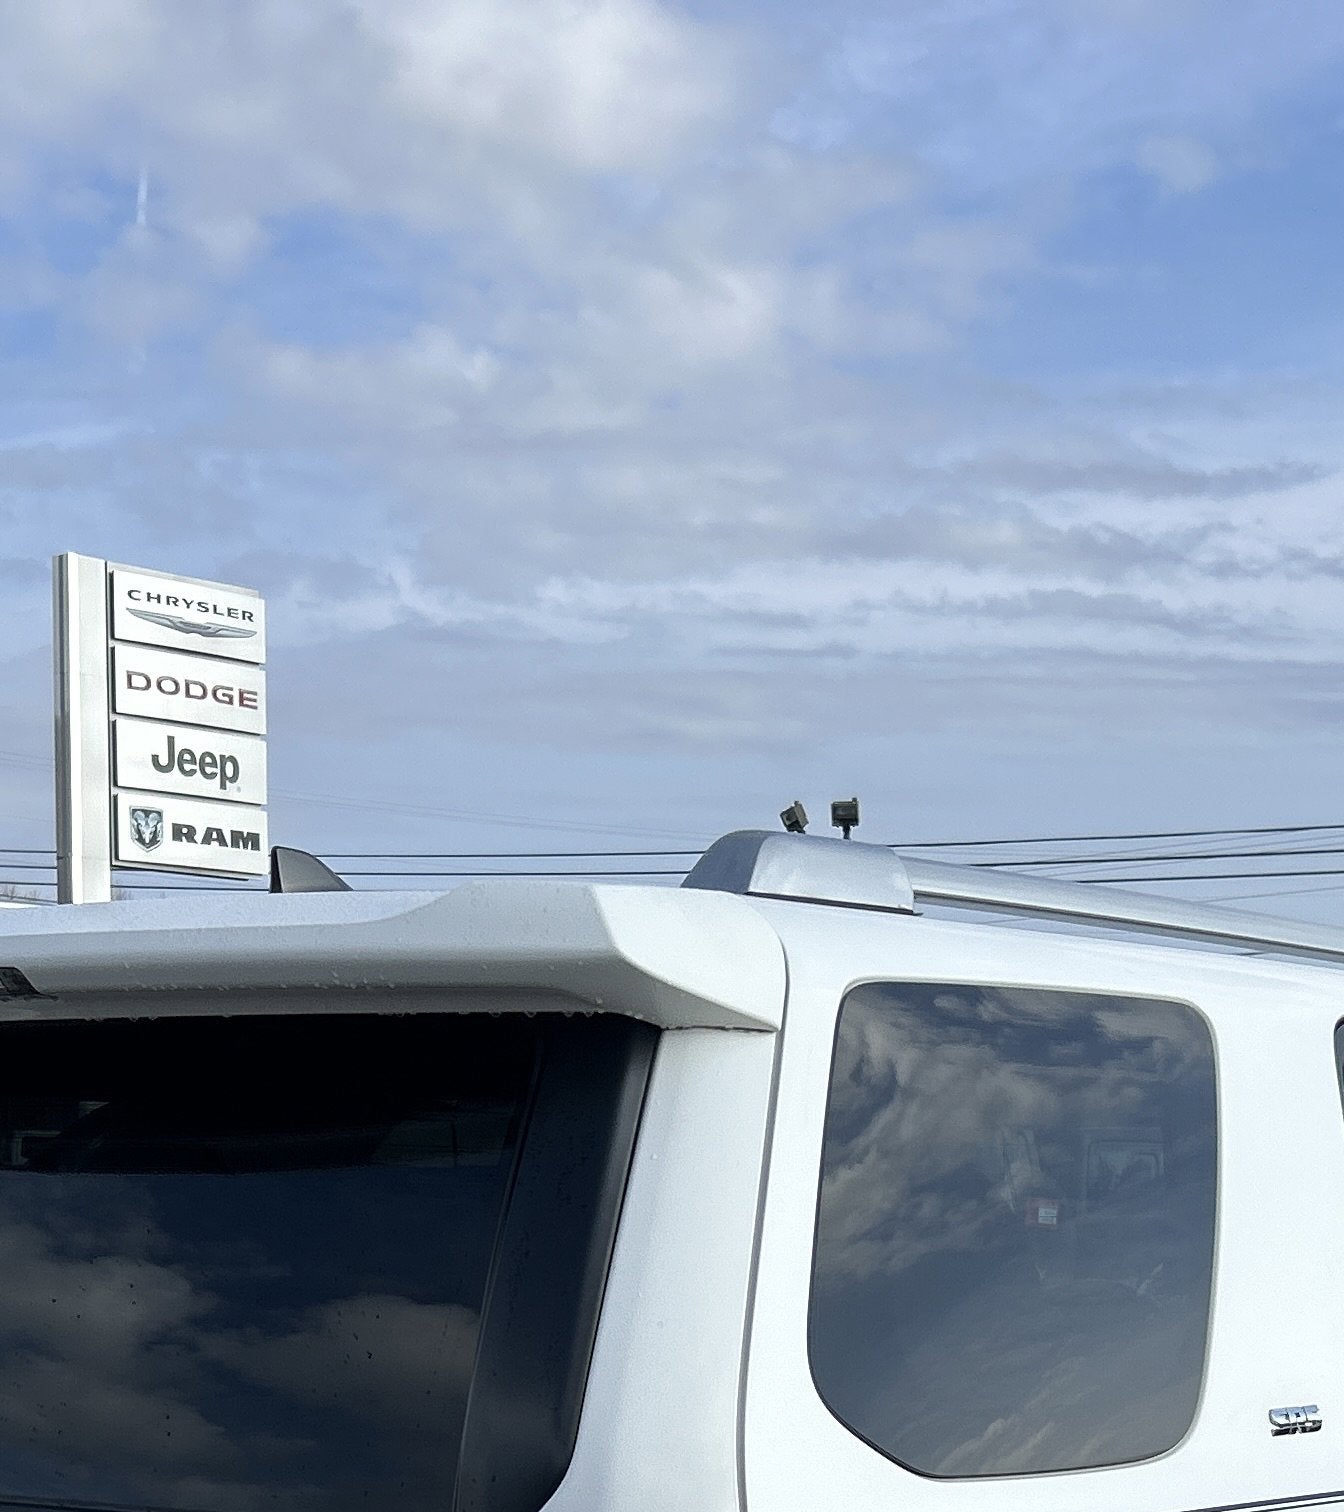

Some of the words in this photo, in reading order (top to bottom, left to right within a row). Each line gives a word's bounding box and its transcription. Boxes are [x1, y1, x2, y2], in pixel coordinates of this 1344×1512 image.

[127, 589, 254, 623] CHRYSLER
[126, 670, 258, 710] DODGE
[151, 735, 240, 790] Jeep
[171, 823, 261, 852] RAM
